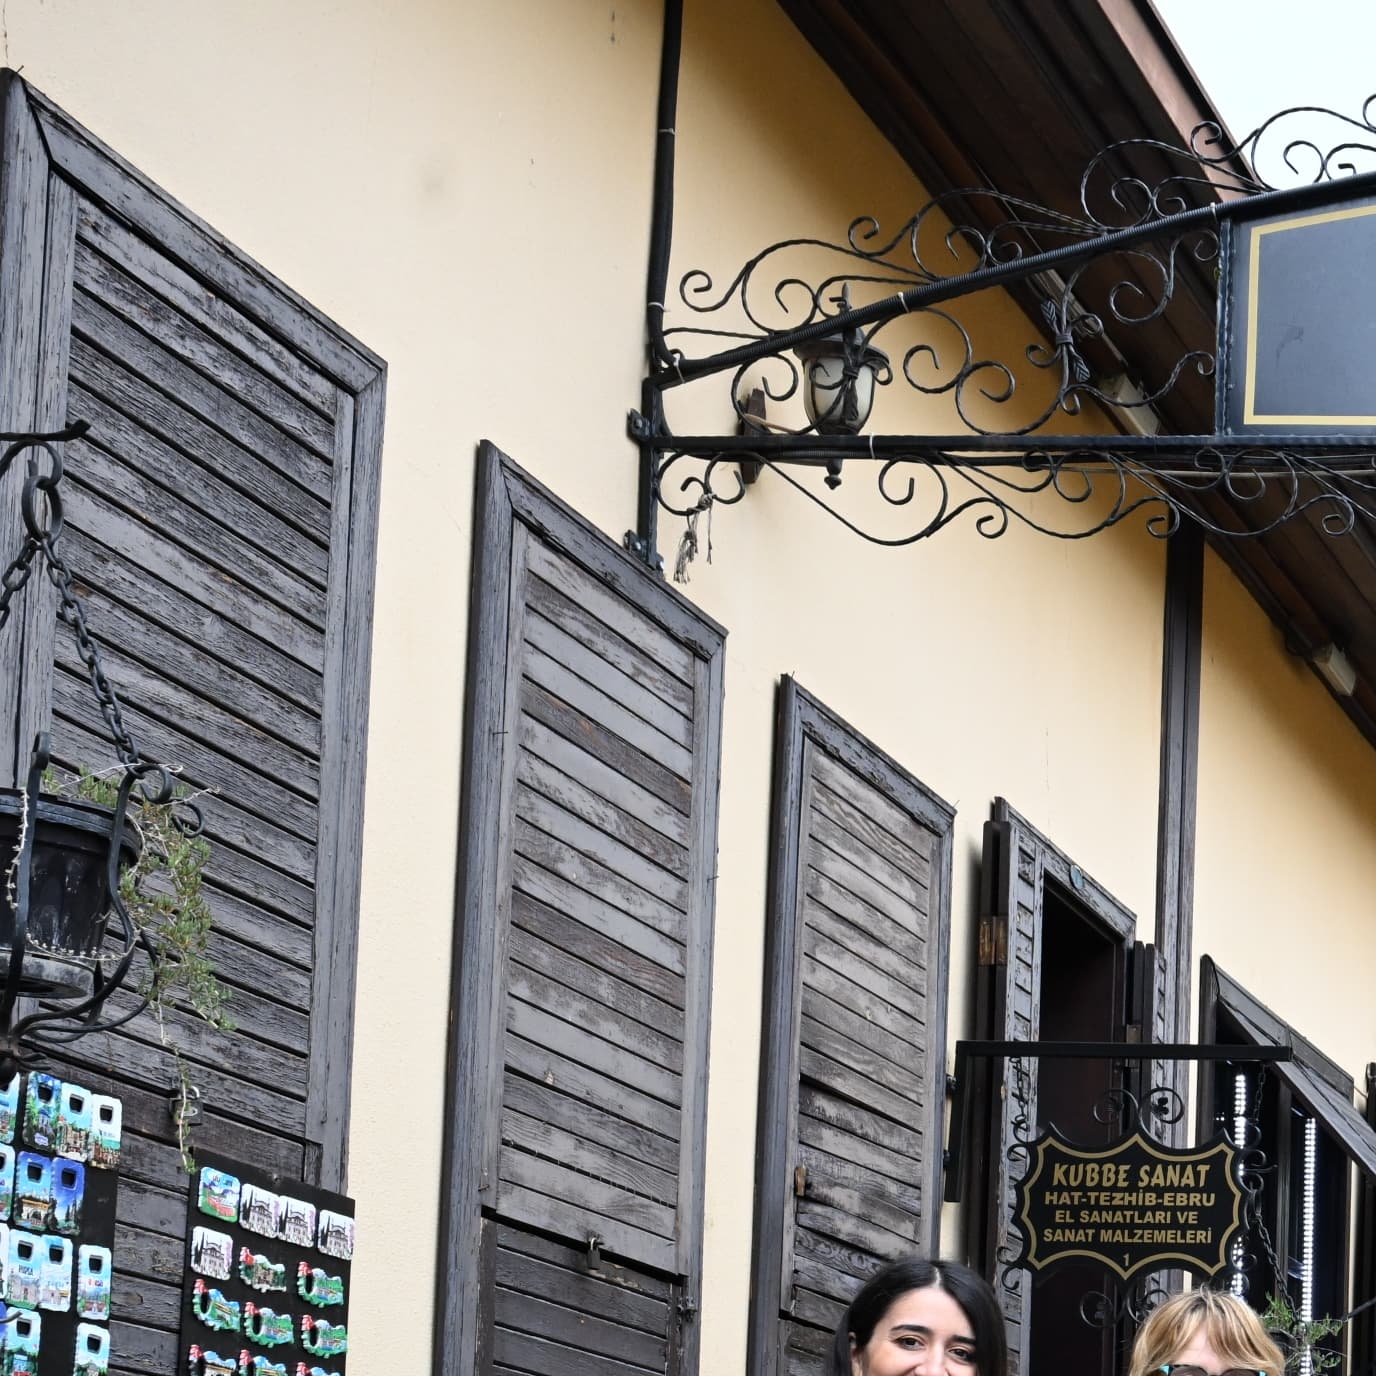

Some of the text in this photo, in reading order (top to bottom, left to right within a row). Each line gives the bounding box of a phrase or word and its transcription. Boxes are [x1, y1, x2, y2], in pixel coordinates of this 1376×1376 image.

[1052, 1163, 1211, 1188] KUBBE SANAT
[1044, 1189, 1216, 1207] HAT-TEZHİB-EBRU
[1055, 1210, 1198, 1225] EL SANATLARI VE
[1043, 1227, 1213, 1244] SANAT MALZEMELERİ
[1123, 1253, 1130, 1267] 1
